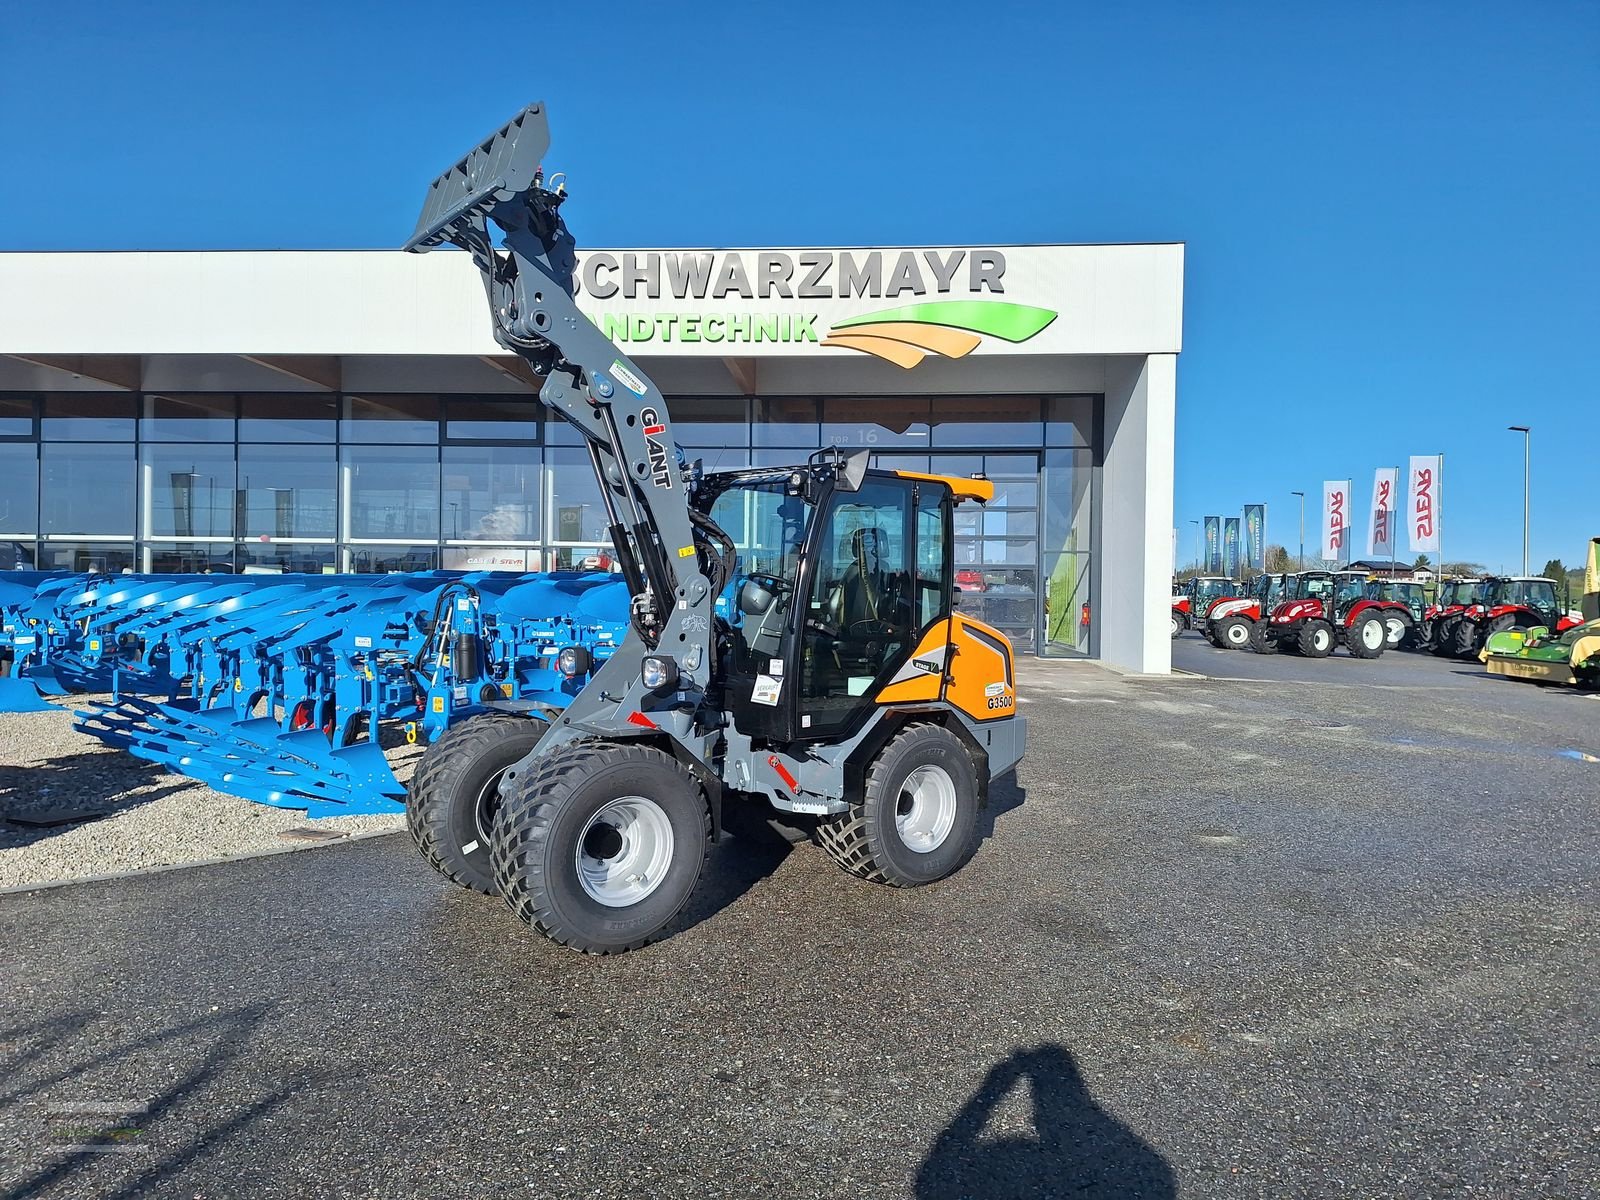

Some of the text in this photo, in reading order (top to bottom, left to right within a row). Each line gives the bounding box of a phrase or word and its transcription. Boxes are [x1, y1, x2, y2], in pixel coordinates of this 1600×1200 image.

[572, 250, 1007, 299] CHWARZMAYR
[586, 312, 819, 342] NDTECHNIK
[857, 429, 878, 444] 16
[930, 662, 937, 672] V
[987, 695, 1013, 710] G3500
